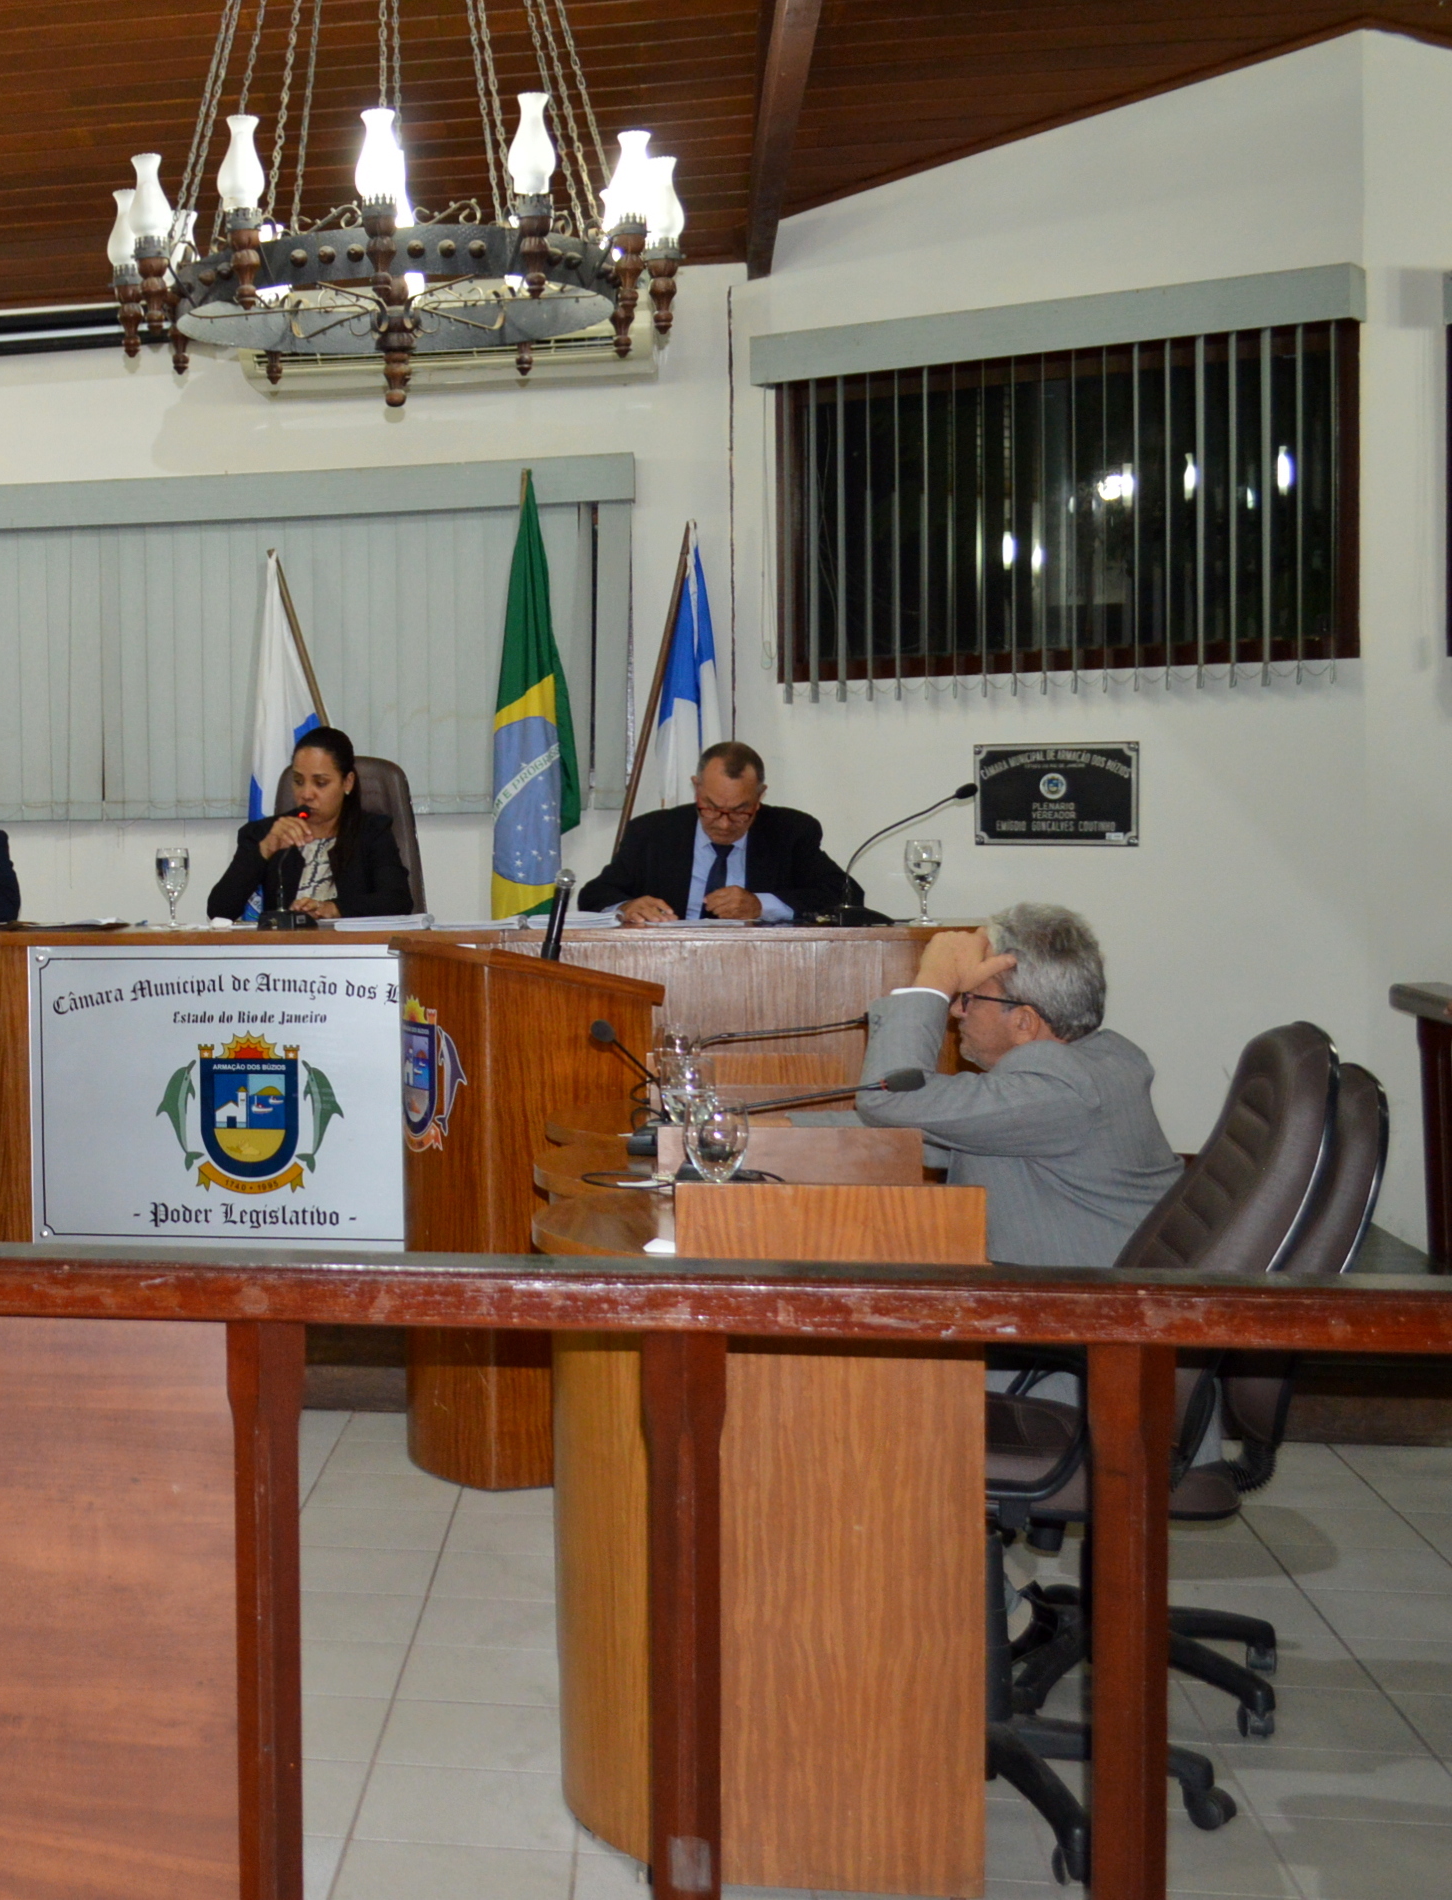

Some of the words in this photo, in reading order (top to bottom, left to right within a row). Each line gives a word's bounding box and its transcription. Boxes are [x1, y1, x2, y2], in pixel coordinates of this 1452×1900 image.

[1031, 811, 1077, 819] VEREADOR
[52, 987, 125, 1015] Câmara
[129, 974, 225, 1001] Municipal
[231, 974, 251, 993] de
[255, 972, 338, 1001] Armação
[345, 979, 378, 1001] dos
[173, 1010, 215, 1024] Estado
[218, 1010, 234, 1024] do
[237, 1010, 258, 1024] Rio
[260, 1010, 275, 1024] de
[278, 1010, 328, 1026] Janeiro
[212, 1063, 246, 1071] ARMAÇÃO
[261, 1063, 286, 1071] BÚZIOS
[224, 1179, 247, 1191] 1740
[257, 1180, 279, 1191] 1995
[149, 1202, 213, 1228] Poder
[220, 1202, 340, 1229] Legislativo
